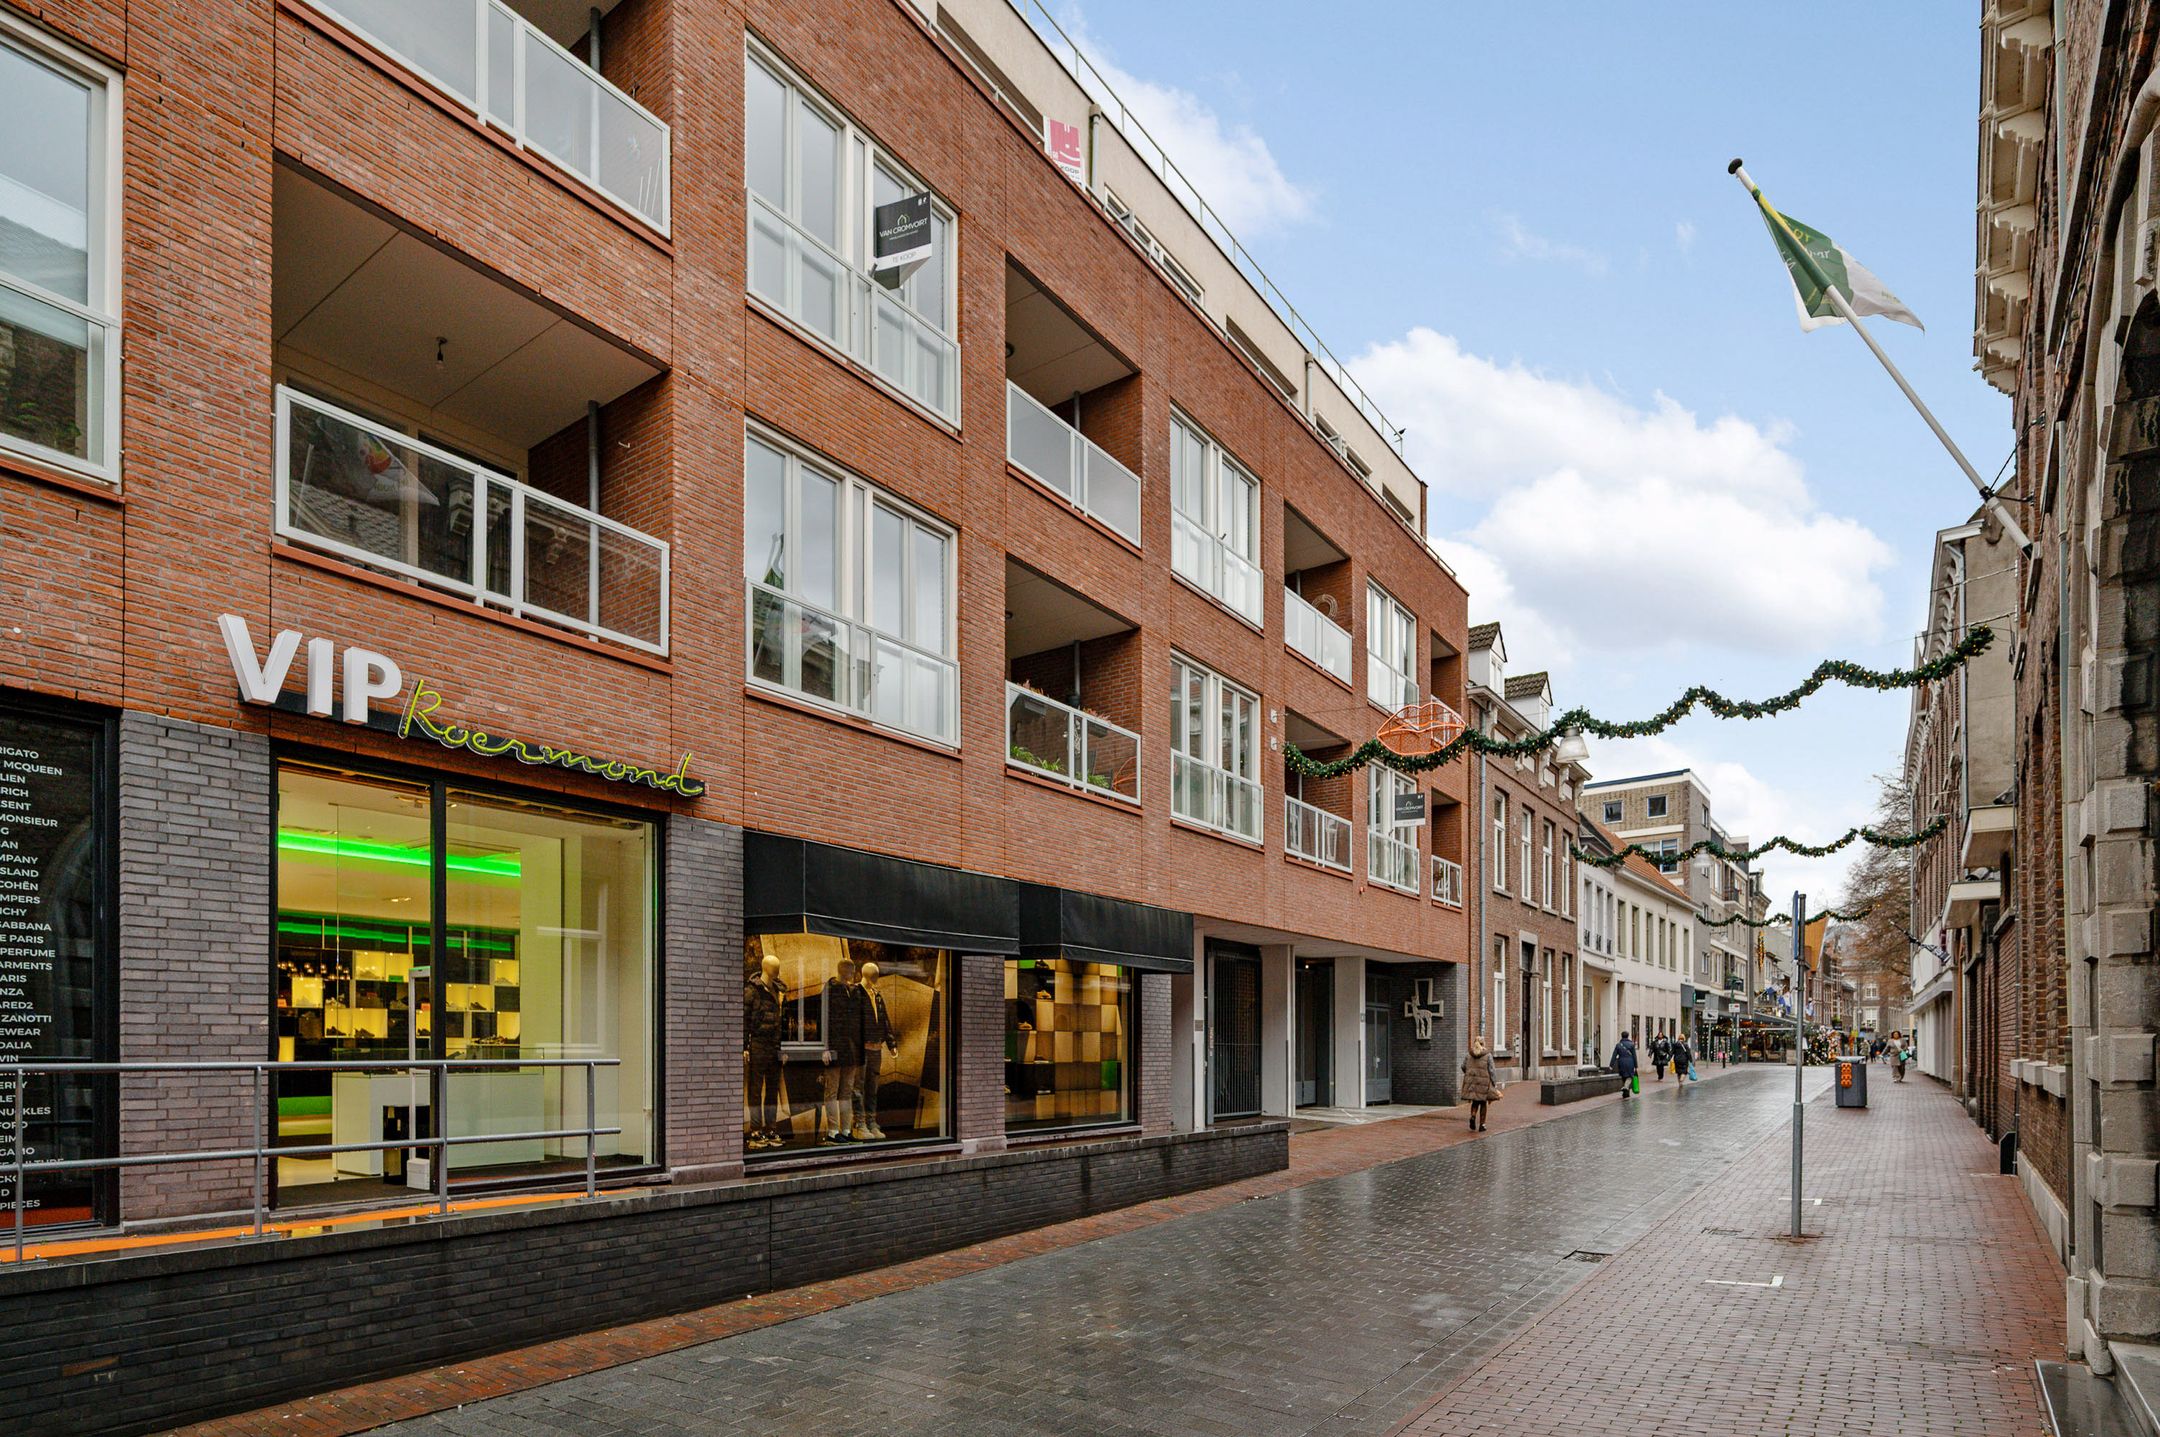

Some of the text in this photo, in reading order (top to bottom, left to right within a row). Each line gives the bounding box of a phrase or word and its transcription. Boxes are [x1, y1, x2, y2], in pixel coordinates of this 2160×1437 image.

[879, 229, 892, 237] VAN
[217, 612, 403, 725] VIP
[399, 678, 704, 798] Roermond
[3, 760, 63, 776] MCQUEEN
[0, 921, 53, 932] ABBANA
[9, 934, 45, 944] PARIS
[0, 947, 56, 958] PERFUME
[0, 1001, 34, 1010] RED2
[0, 1014, 52, 1023] ZANOTTI
